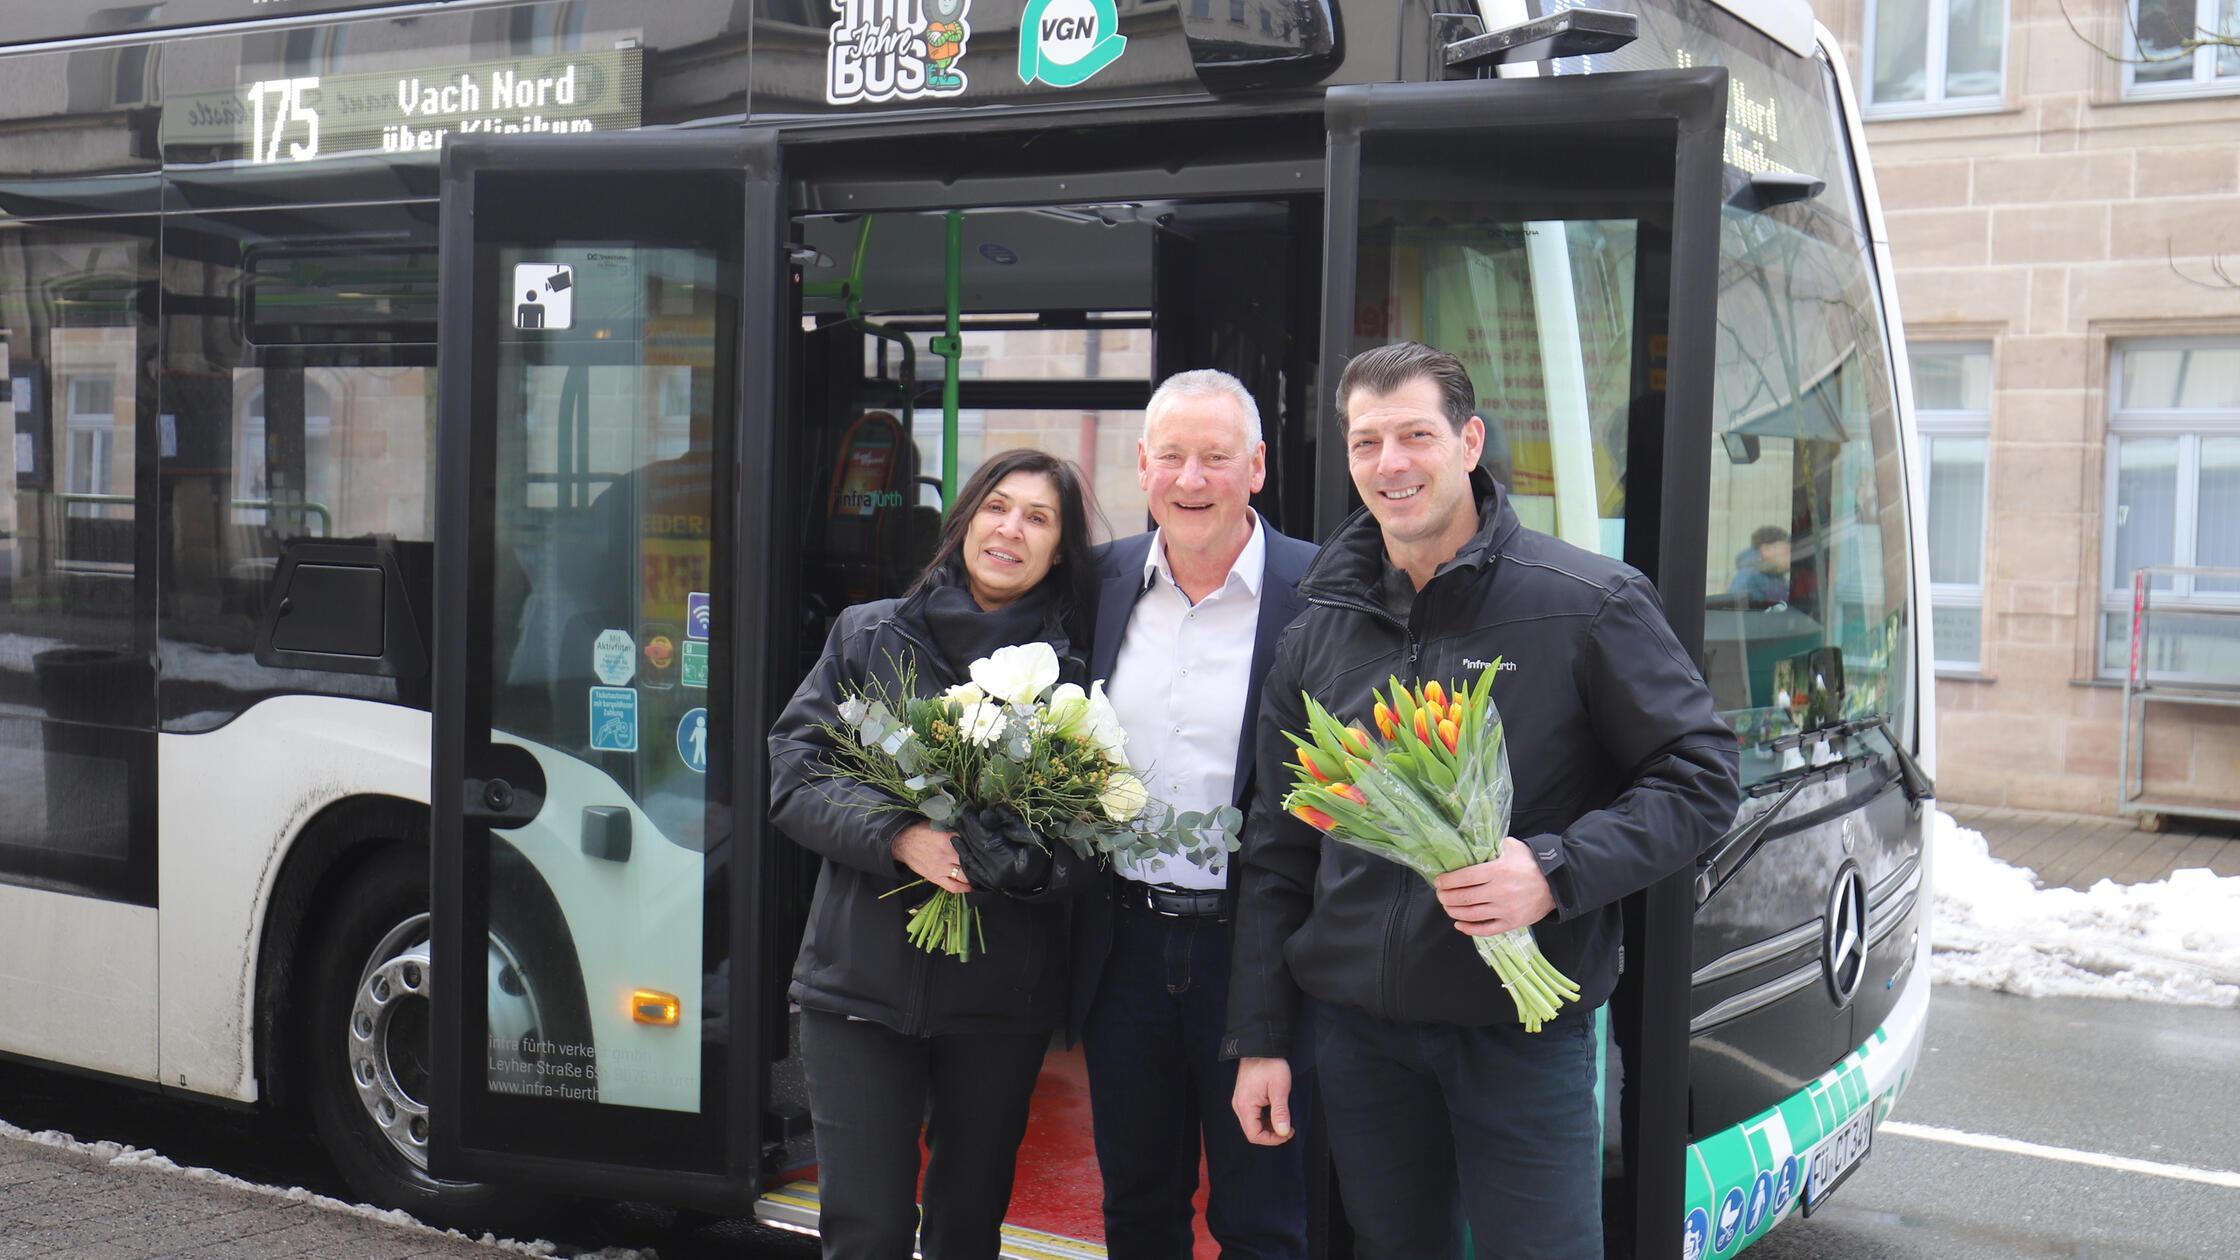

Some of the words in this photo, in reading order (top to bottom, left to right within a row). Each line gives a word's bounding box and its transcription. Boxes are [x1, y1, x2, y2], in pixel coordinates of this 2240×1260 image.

[850, 16, 913, 62] Jahre
[1042, 16, 1095, 41] VGN
[835, 39, 926, 95] BUS
[398, 74, 480, 116] Vach
[491, 65, 576, 110] Nord
[1731, 78, 1778, 142] Nord
[248, 76, 320, 164] 175
[382, 125, 448, 152] über
[488, 1034, 519, 1051] infra
[522, 1037, 555, 1054] fürth
[488, 1057, 533, 1077] Leyher
[536, 1060, 582, 1079] Straße
